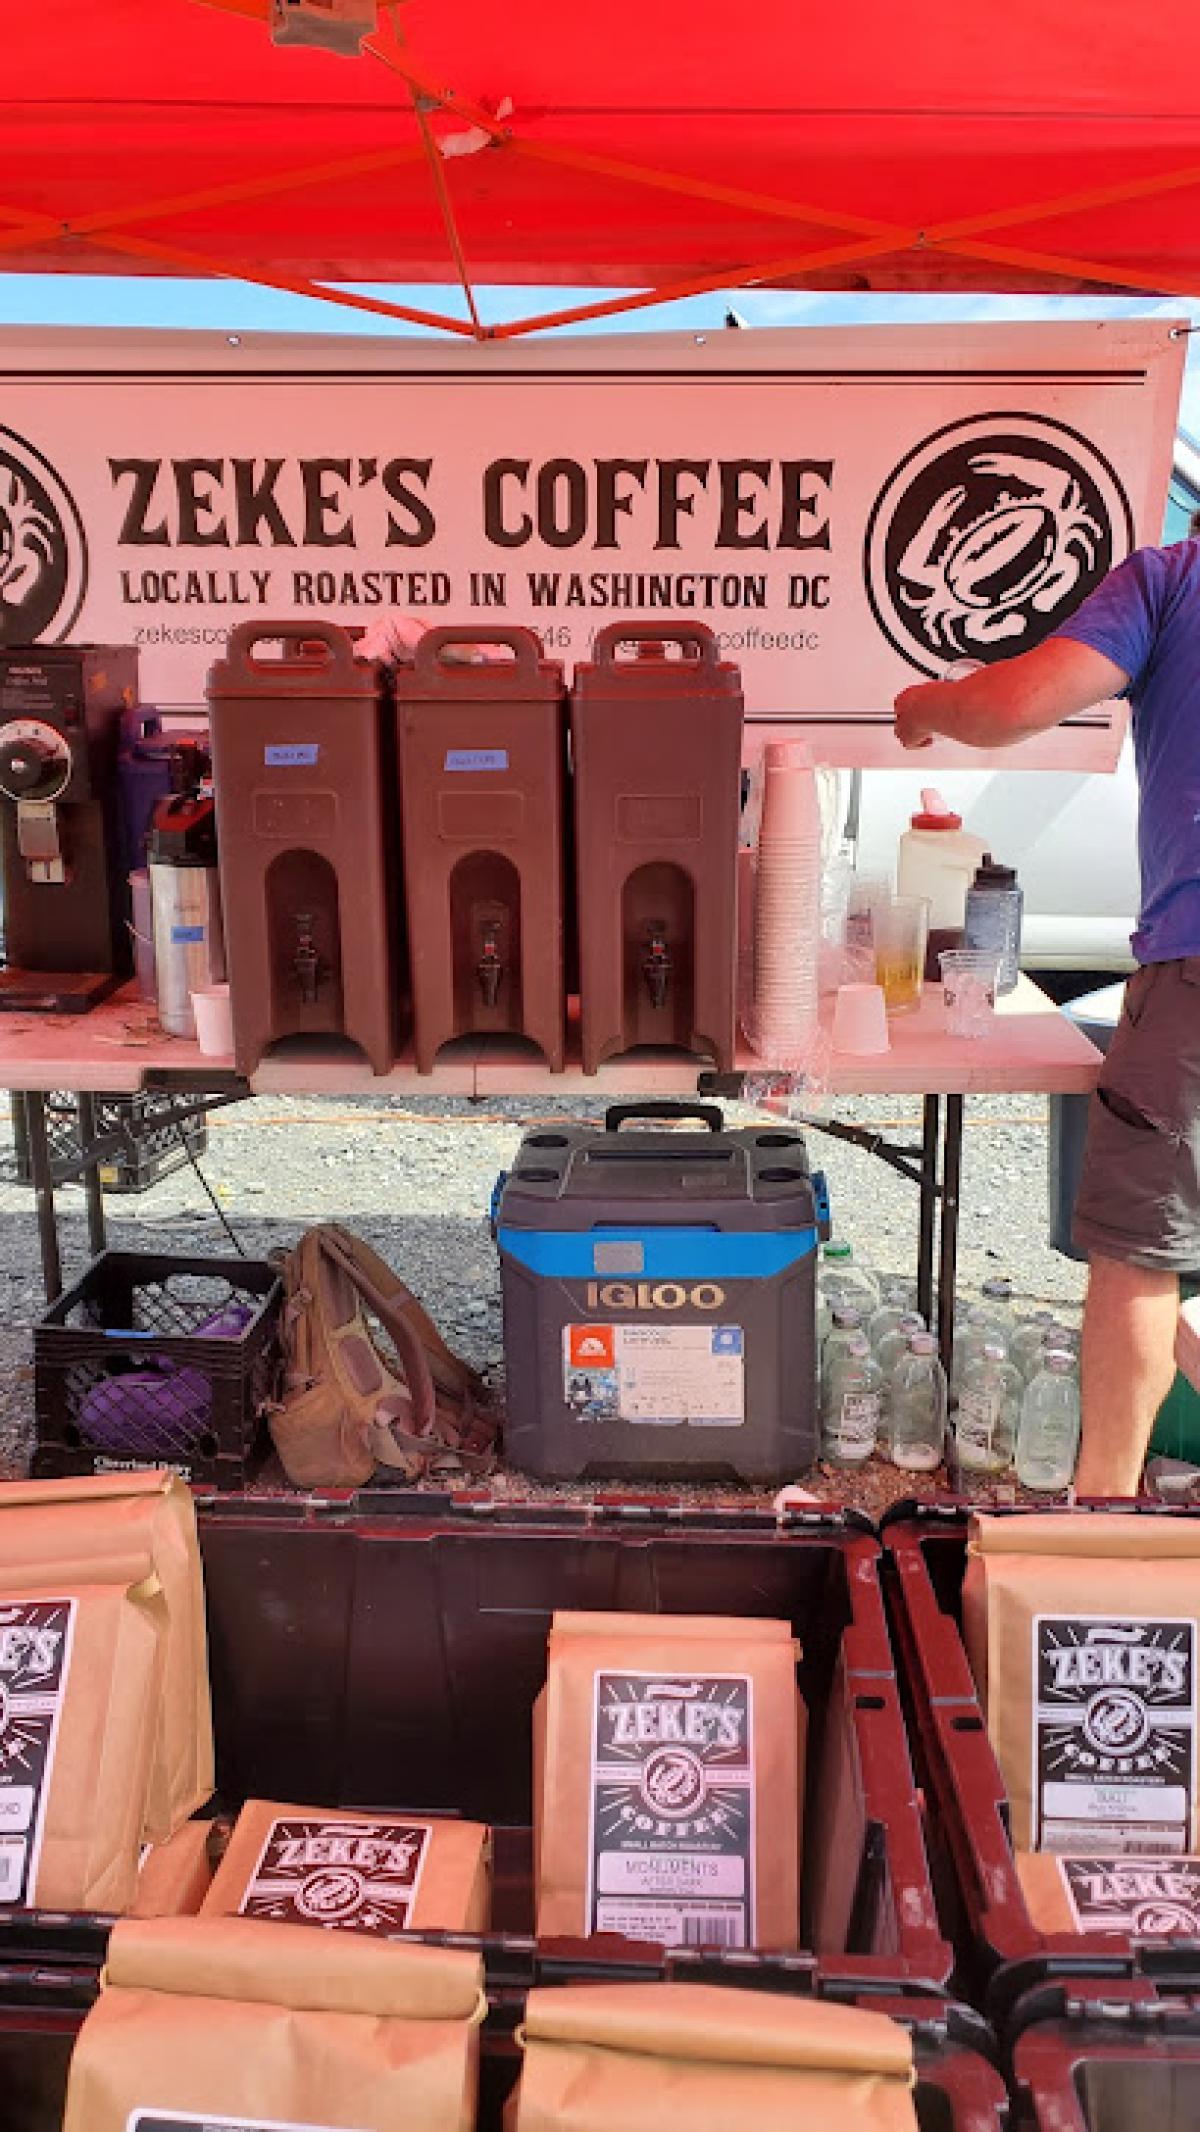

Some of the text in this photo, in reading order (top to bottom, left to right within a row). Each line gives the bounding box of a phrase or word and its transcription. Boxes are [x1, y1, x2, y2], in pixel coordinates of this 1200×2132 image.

[108, 457, 834, 550] ZEKE'S COFFEE
[119, 570, 830, 608] LOCALLY ROASTED IN WASHINGTON DC
[586, 1282, 726, 1309] IGLOO
[0, 1626, 62, 1673] E'S
[1042, 1646, 1189, 1688] ZEKE'S
[601, 1702, 744, 1746] ZEKE'S
[1063, 1743, 1171, 1773] COFFEE
[620, 1805, 729, 1836] COFFEE
[273, 1838, 419, 1871] ZEKE'S
[626, 1859, 719, 1877] MONUMENTS
